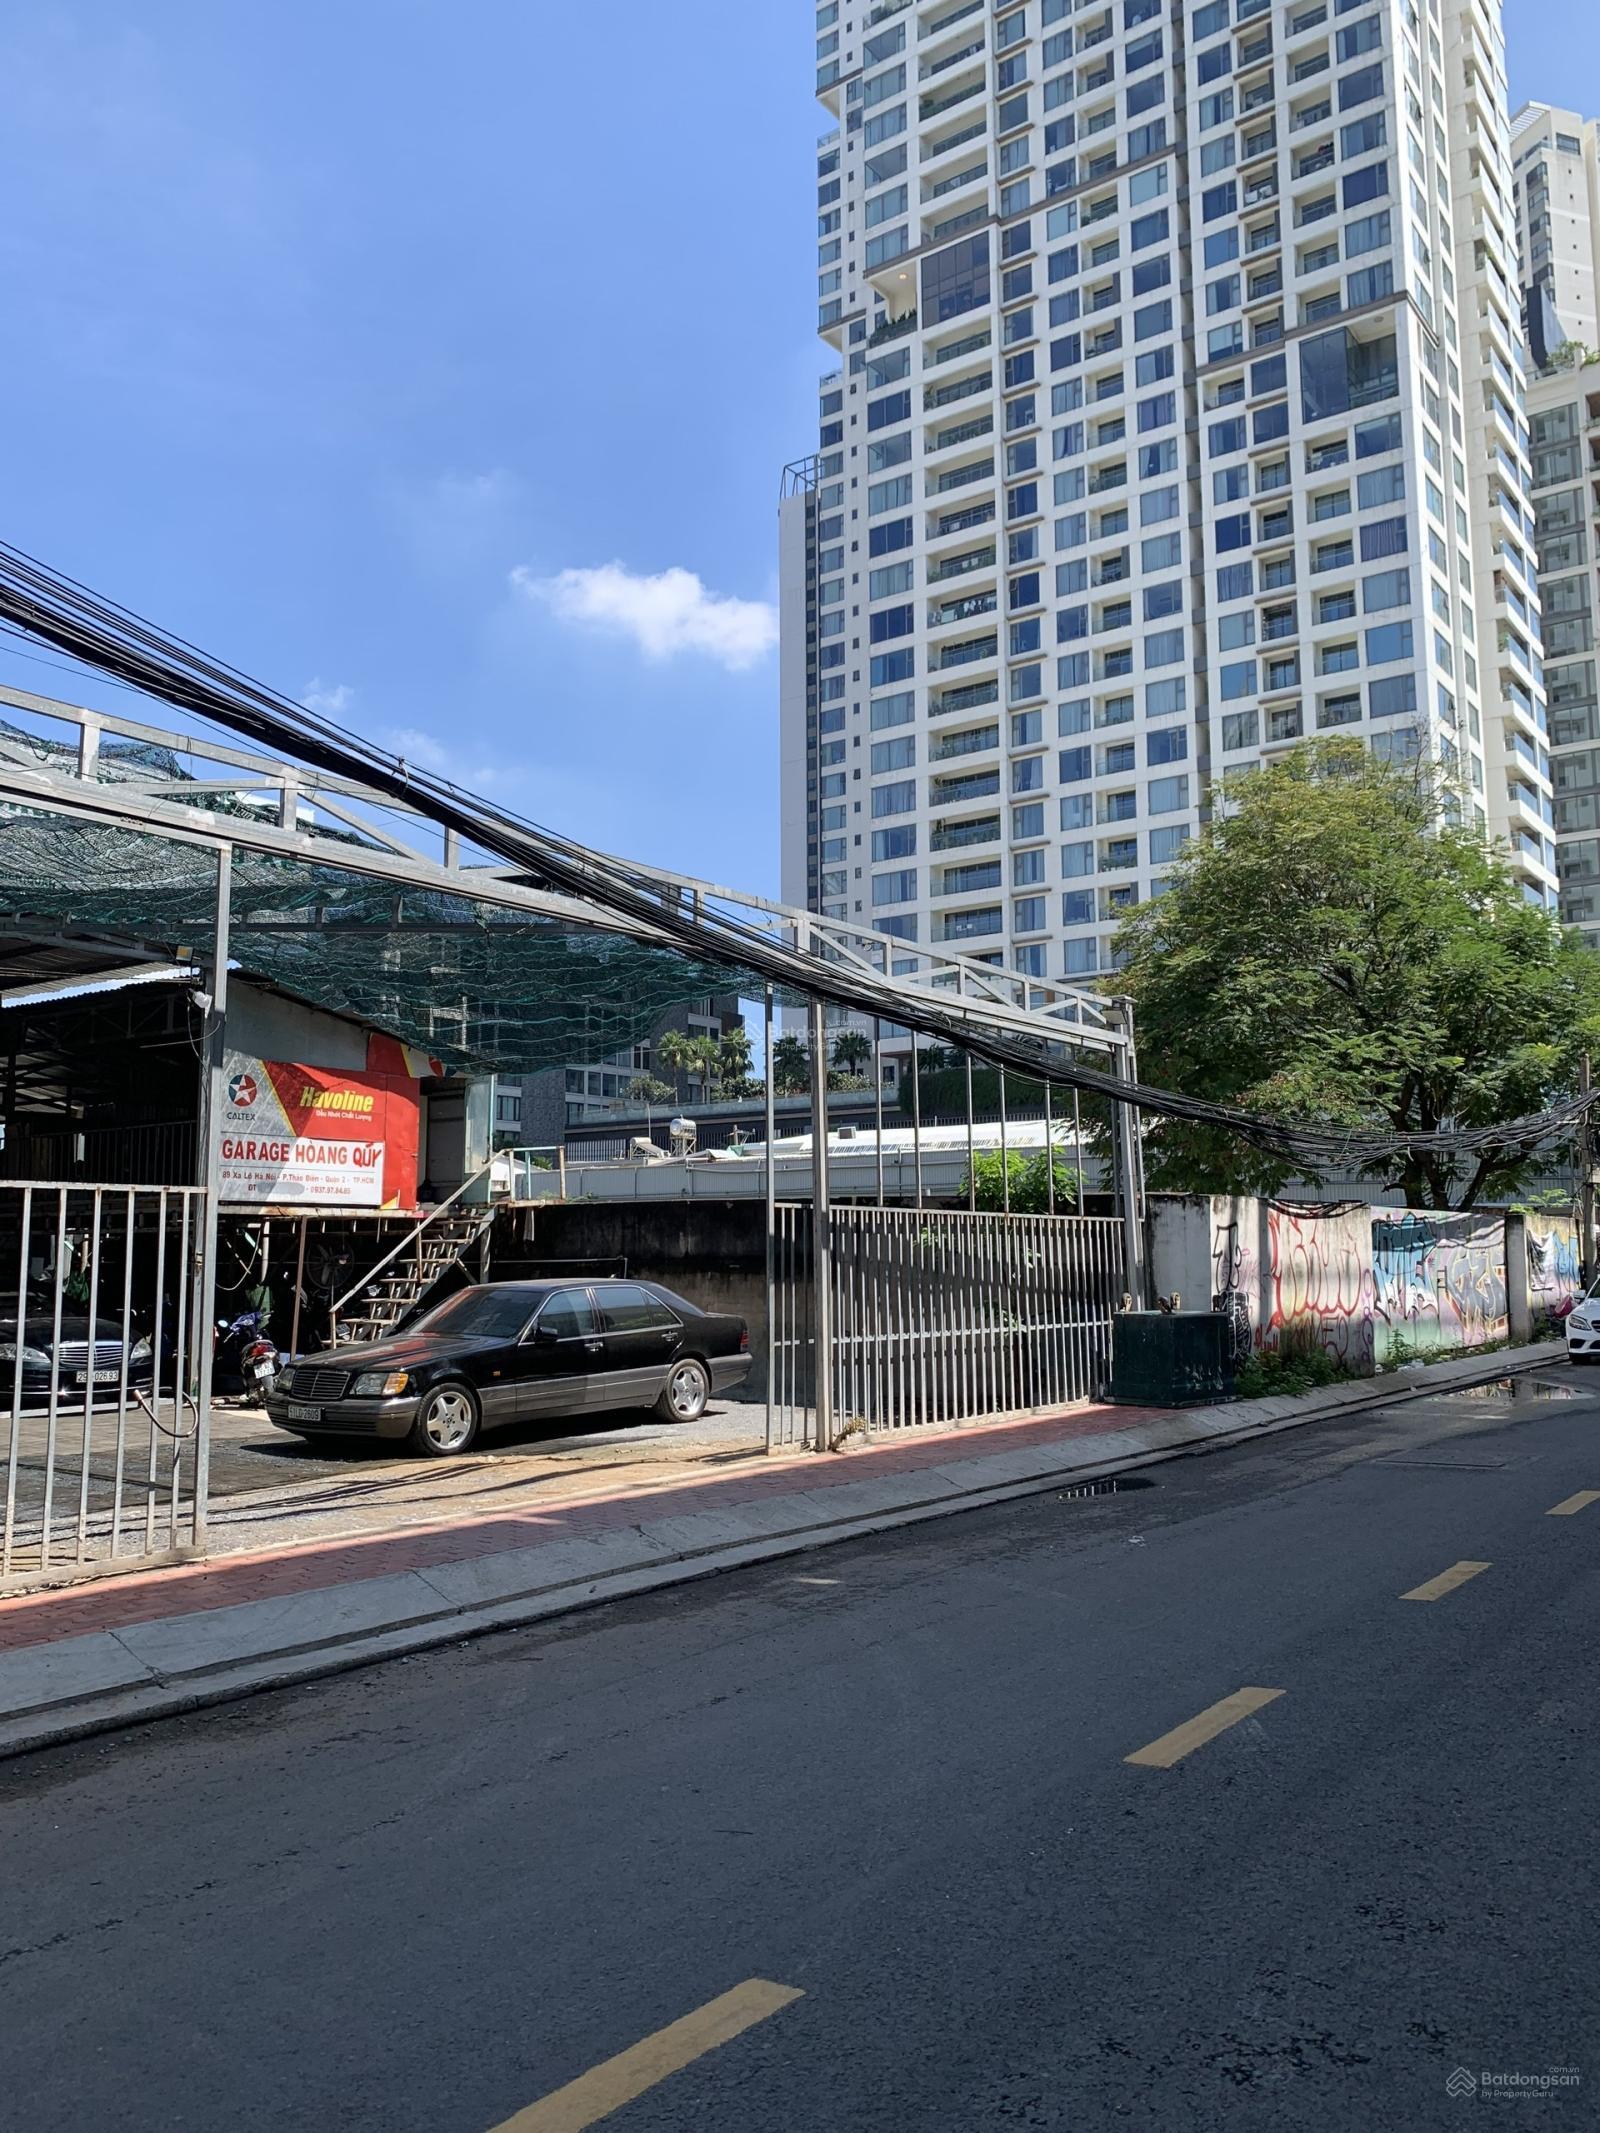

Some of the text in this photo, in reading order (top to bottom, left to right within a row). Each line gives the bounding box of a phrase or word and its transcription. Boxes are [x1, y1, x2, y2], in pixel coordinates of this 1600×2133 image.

[301, 1086, 374, 1112] Havoline
[226, 1112, 256, 1121] CALTEX
[222, 1139, 290, 1162] GARAGE
